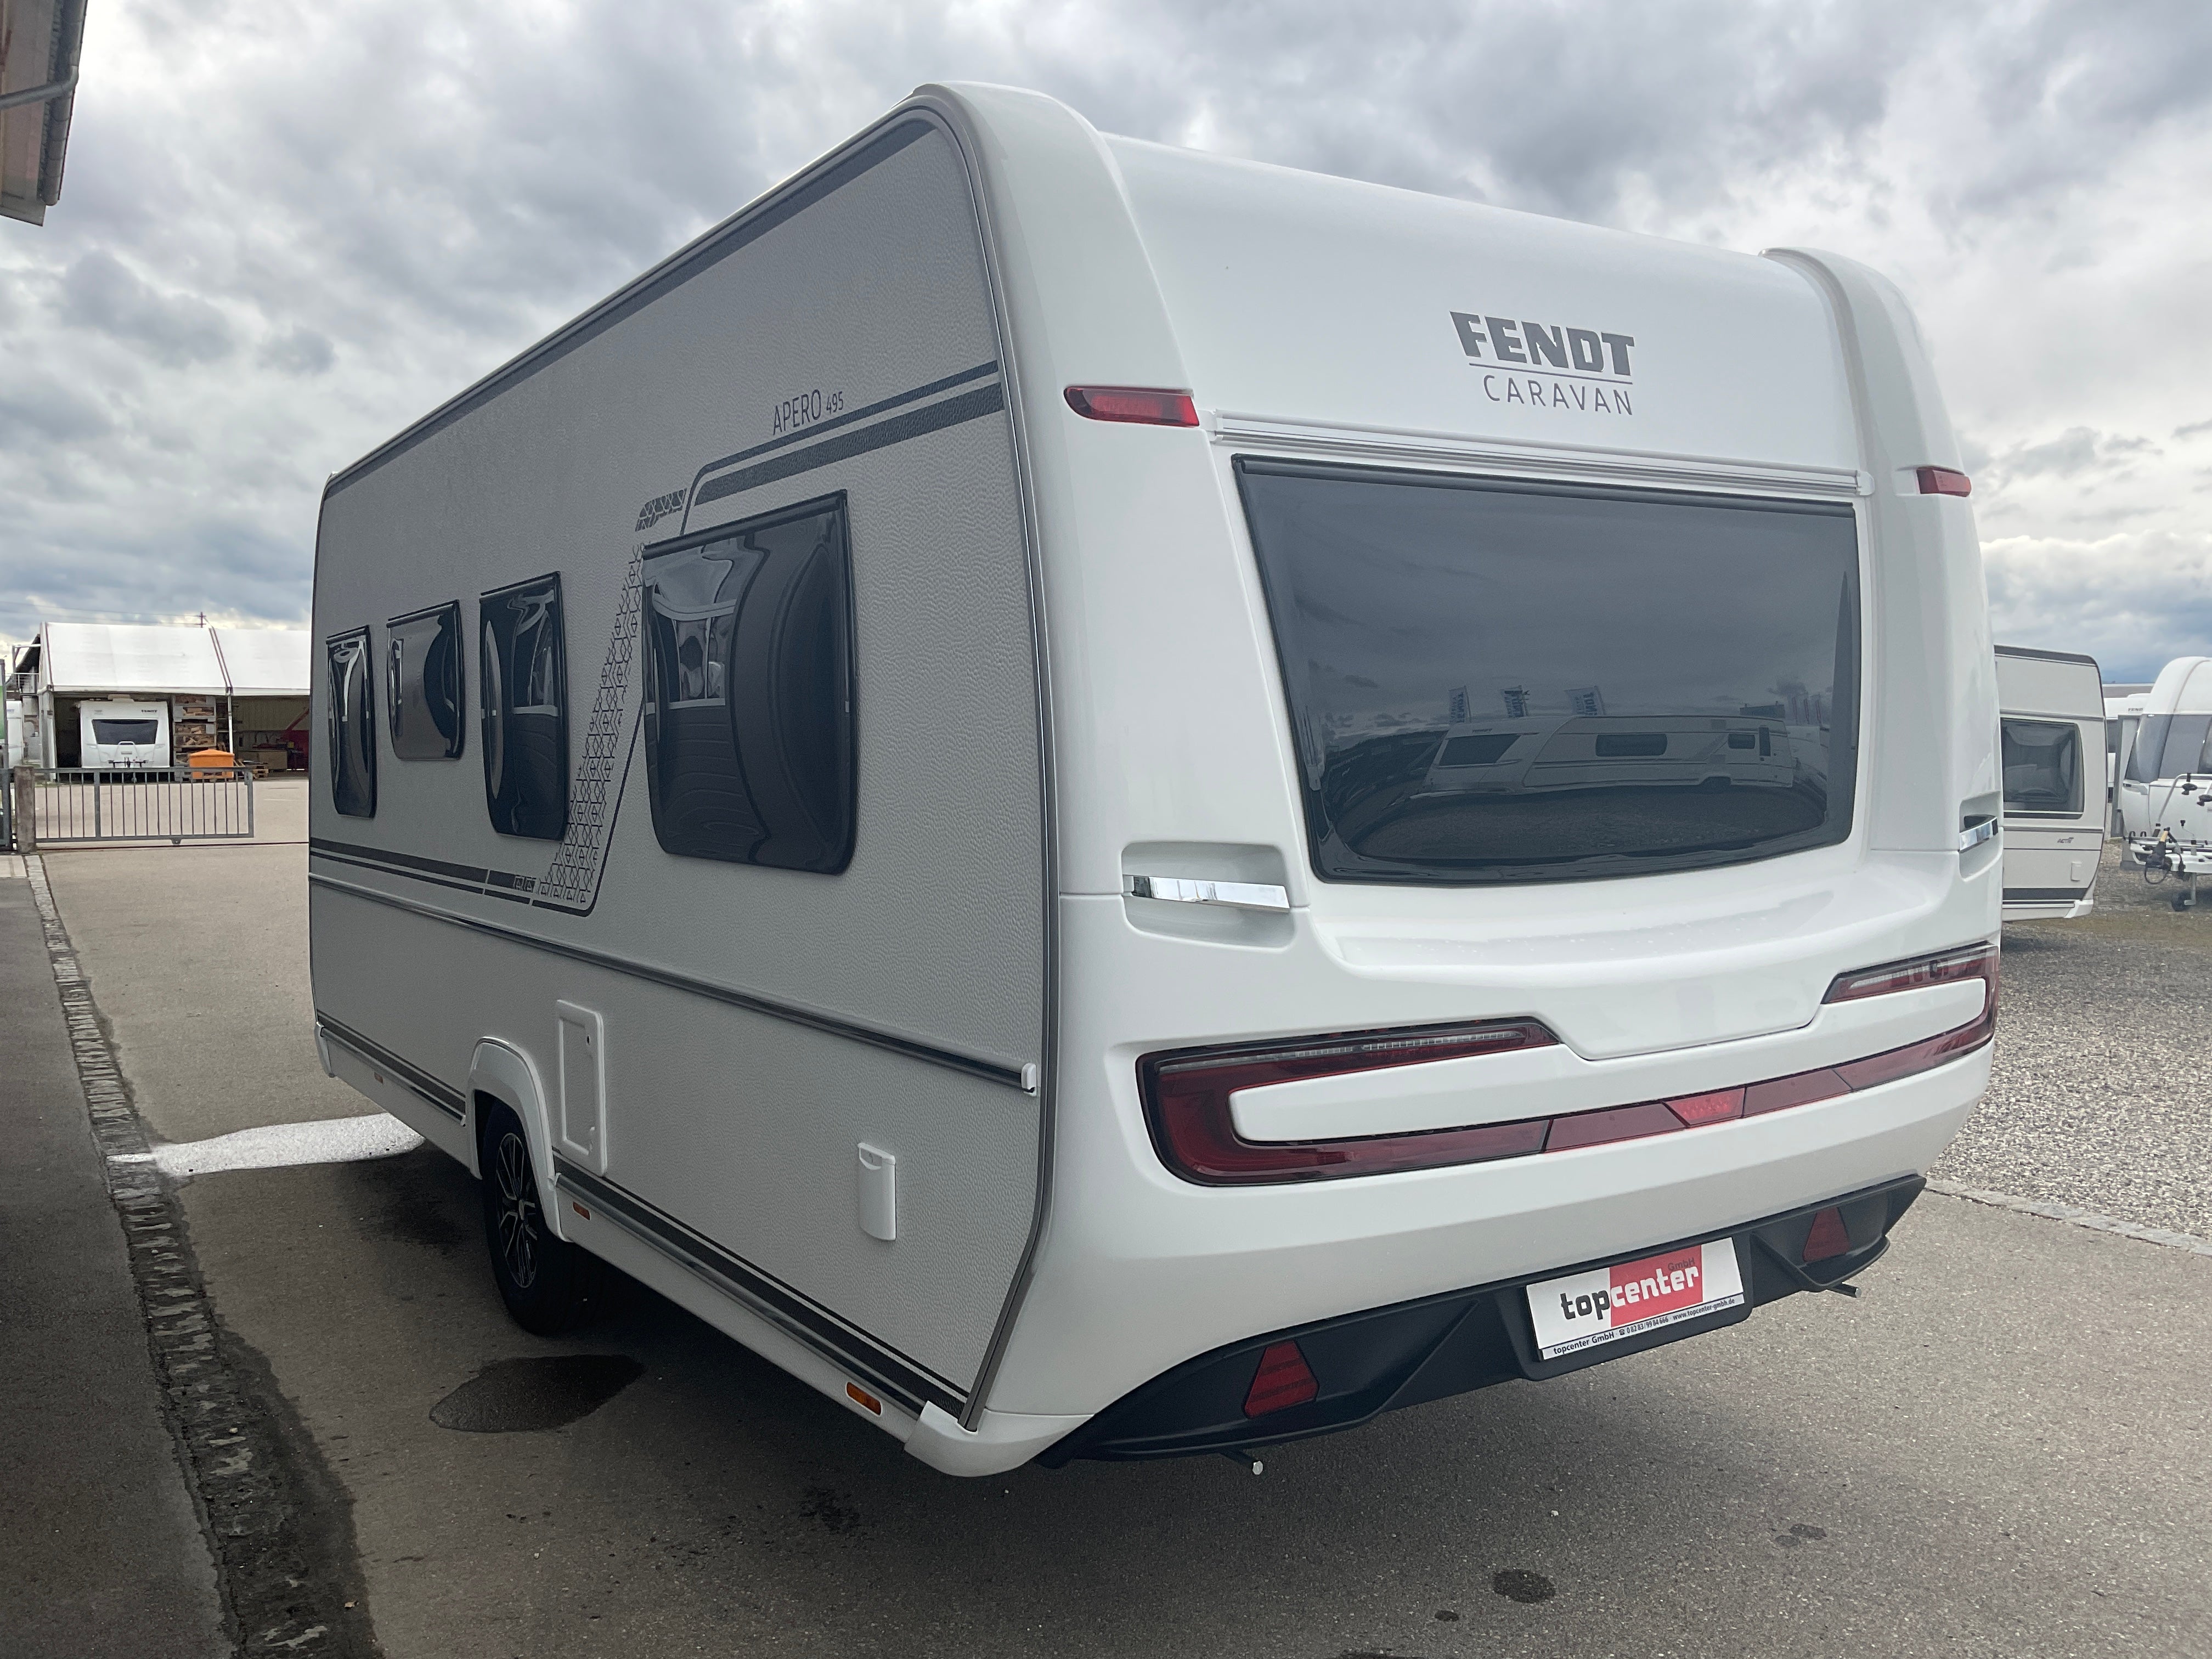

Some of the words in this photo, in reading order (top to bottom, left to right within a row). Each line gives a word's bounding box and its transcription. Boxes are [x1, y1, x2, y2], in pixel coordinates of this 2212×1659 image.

[1449, 311, 1634, 376] FENDT
[773, 389, 821, 435] APERO
[826, 391, 843, 415] 495
[1483, 375, 1633, 415] CARAVAN
[1668, 1257, 1695, 1271] GmbH
[1553, 1339, 1590, 1355] topcenter
[1592, 1331, 1615, 1344] GmbH
[1672, 1297, 1735, 1321] www.topcenter-gmbh.de
